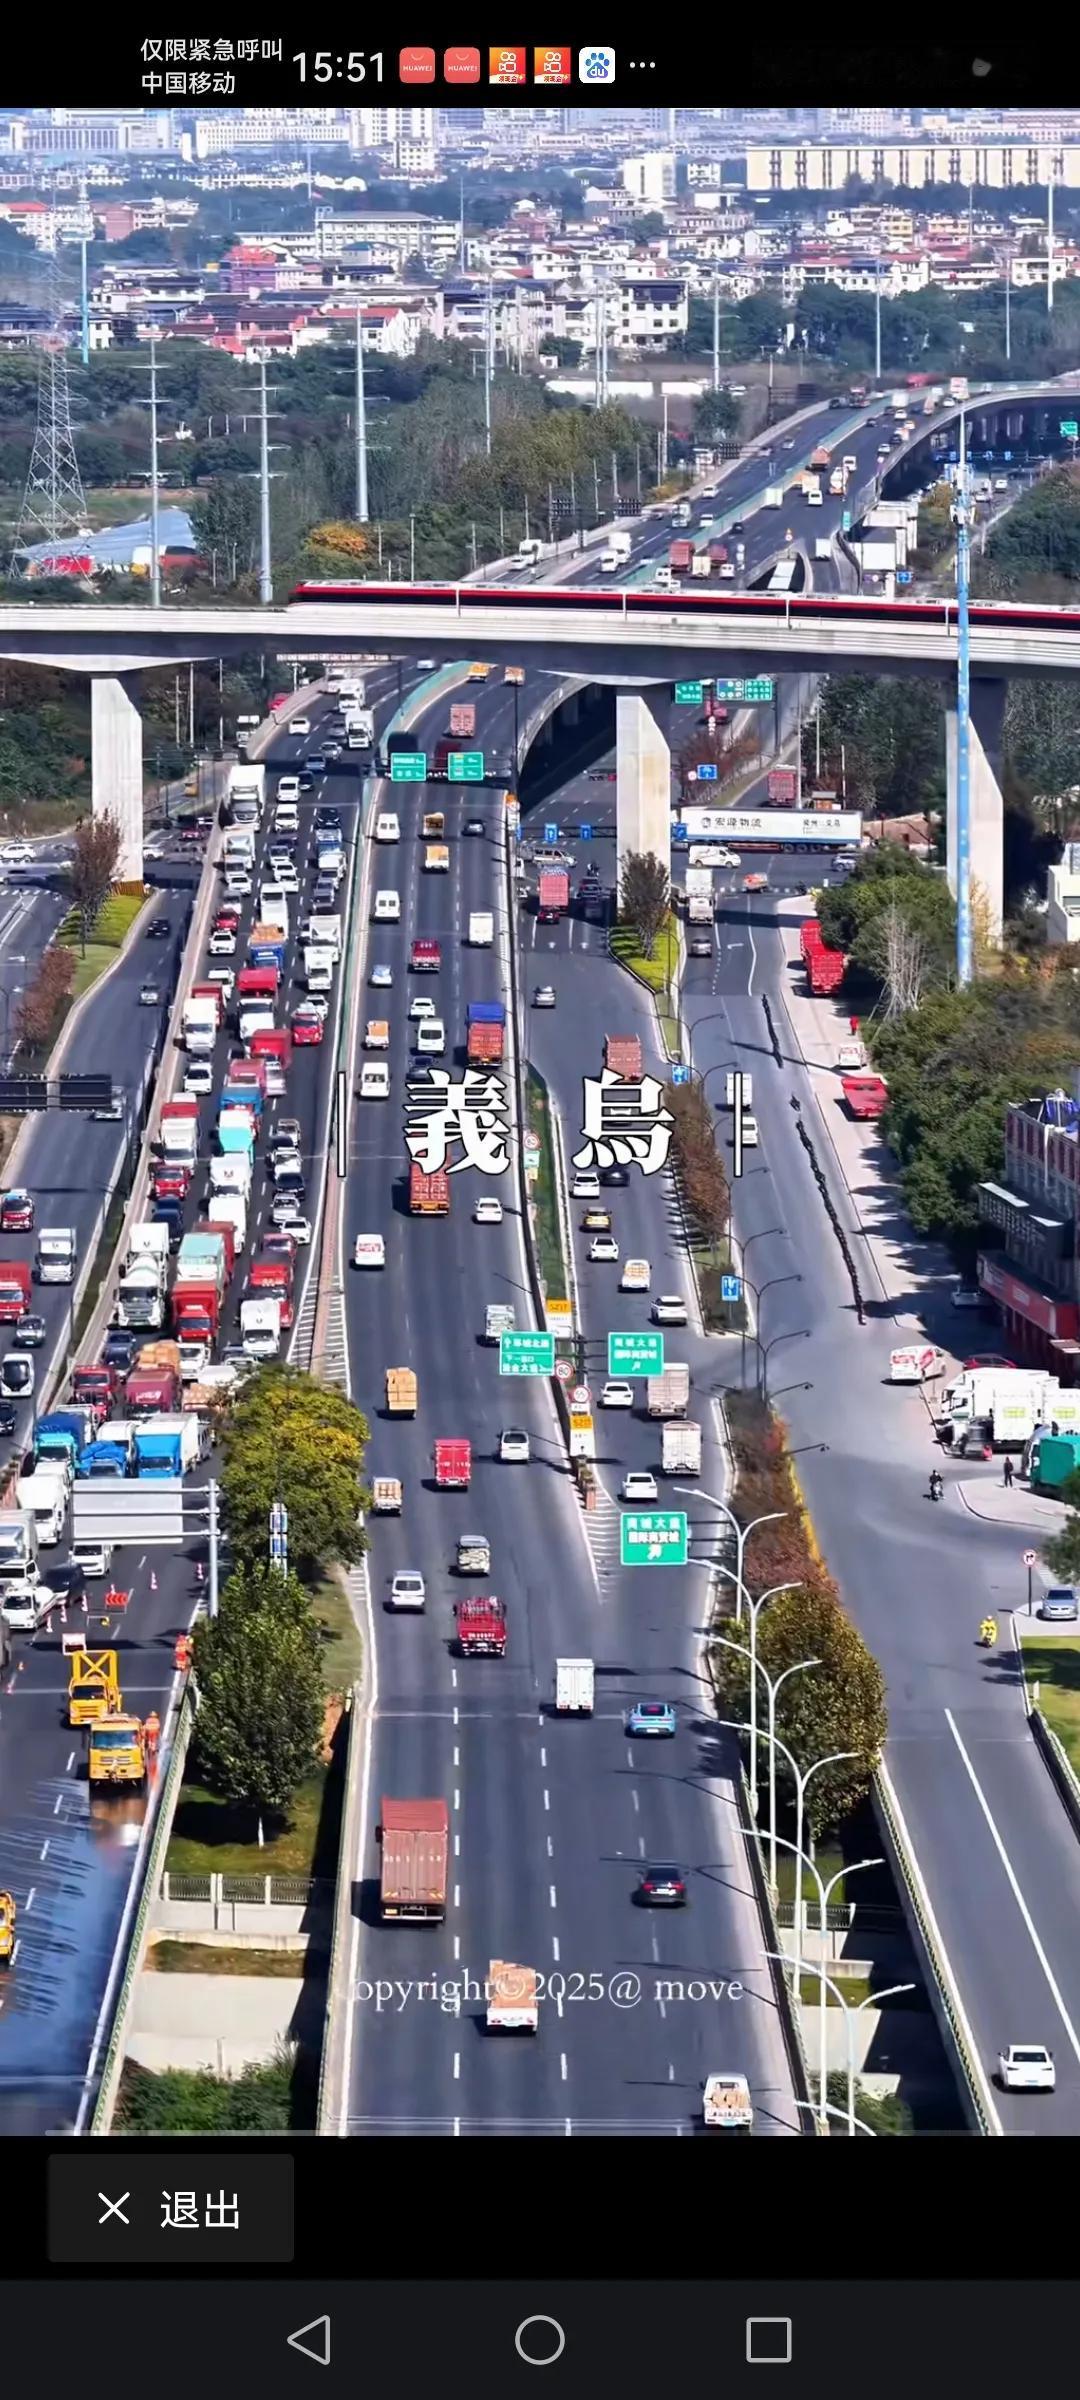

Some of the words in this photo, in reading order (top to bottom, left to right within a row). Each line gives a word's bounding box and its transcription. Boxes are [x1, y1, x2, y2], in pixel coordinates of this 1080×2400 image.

[140, 38, 283, 62] 仅限紧急呼叫
[292, 51, 384, 83] 15:51
[590, 66, 605, 77] du
[141, 71, 236, 95] 中国移动
[160, 2189, 239, 2230] 退出
